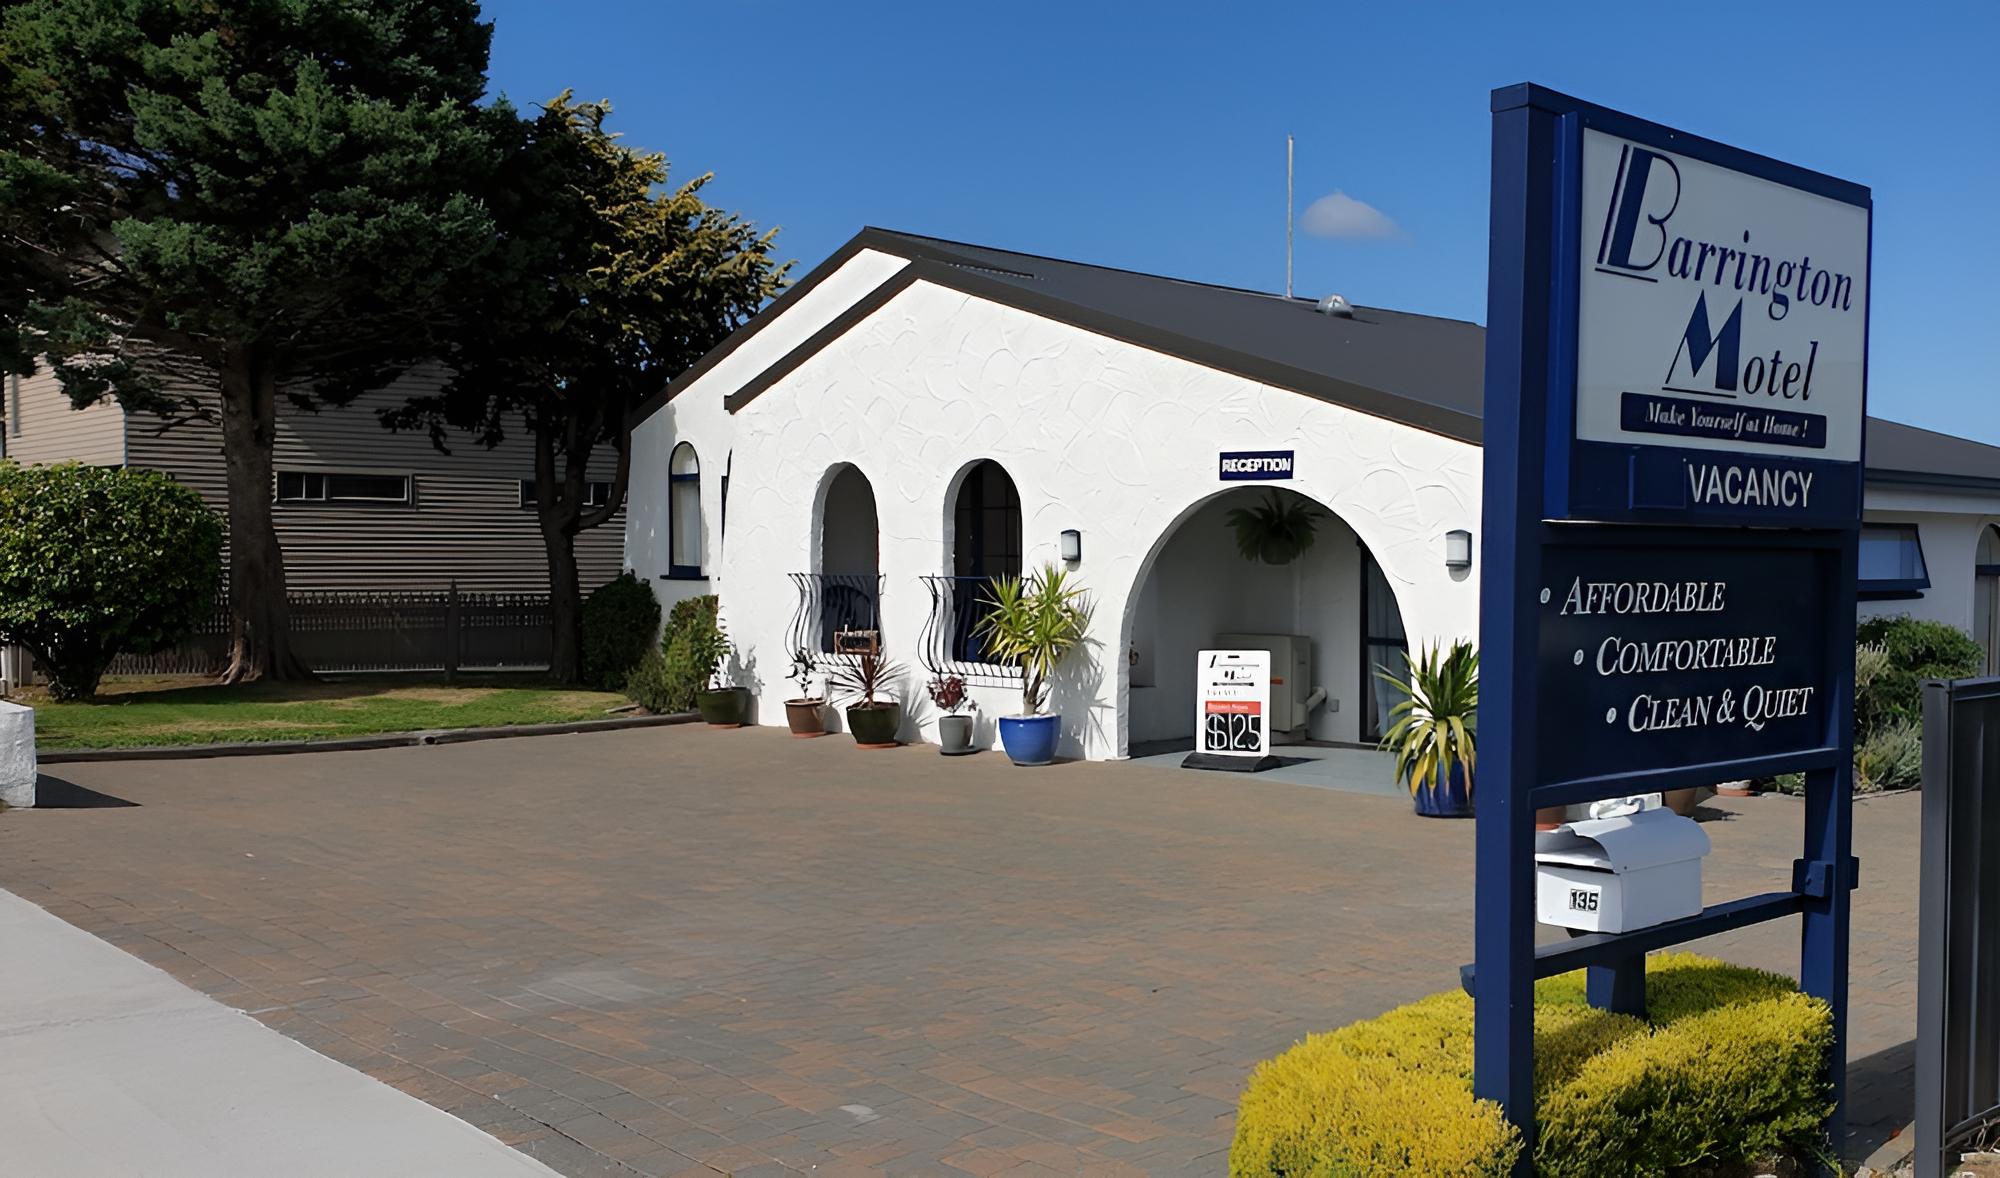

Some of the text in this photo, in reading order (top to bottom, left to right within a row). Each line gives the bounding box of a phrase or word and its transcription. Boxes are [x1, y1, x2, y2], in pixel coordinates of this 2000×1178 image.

[1596, 144, 1853, 321] Barrington
[1662, 289, 1818, 401] Motel
[1645, 402, 1686, 426] Make
[1691, 406, 1747, 438] Yourself
[1222, 458, 1292, 473] RECEPTION
[1688, 463, 1814, 508] VACANCY
[1560, 576, 1726, 615] AFFORDABLE
[1596, 636, 1777, 676] COMFORTABLE
[1628, 685, 1814, 732] CLEAN & QUIET
[1571, 891, 1599, 911] 135
